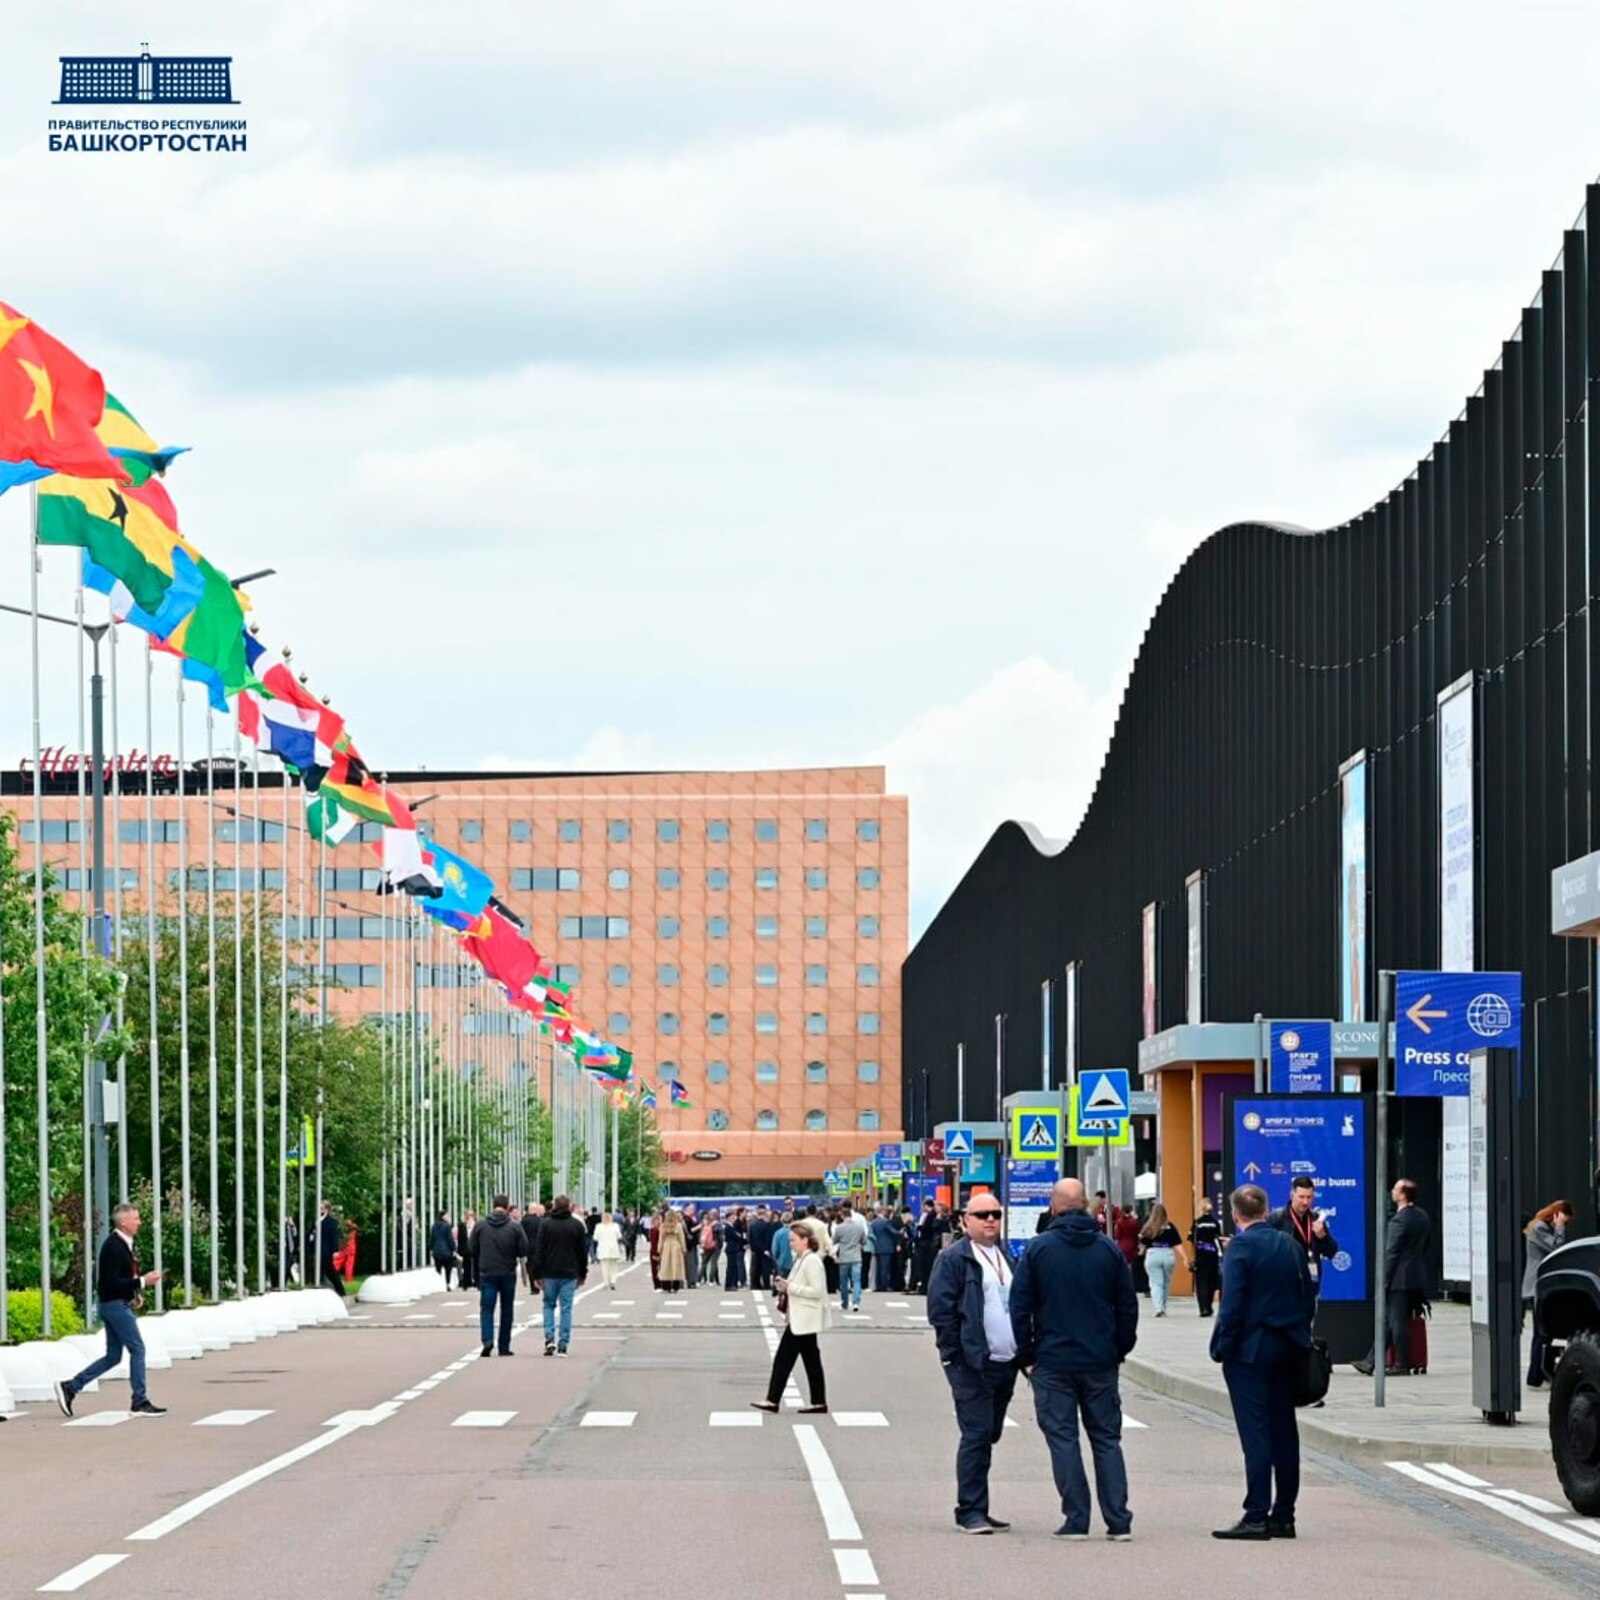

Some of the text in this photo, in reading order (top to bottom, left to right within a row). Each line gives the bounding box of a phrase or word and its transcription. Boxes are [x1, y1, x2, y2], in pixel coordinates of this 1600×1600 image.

[1404, 1047, 1451, 1065] Press
[969, 1153, 984, 1174] F
[1328, 1177, 1357, 1187] buses
